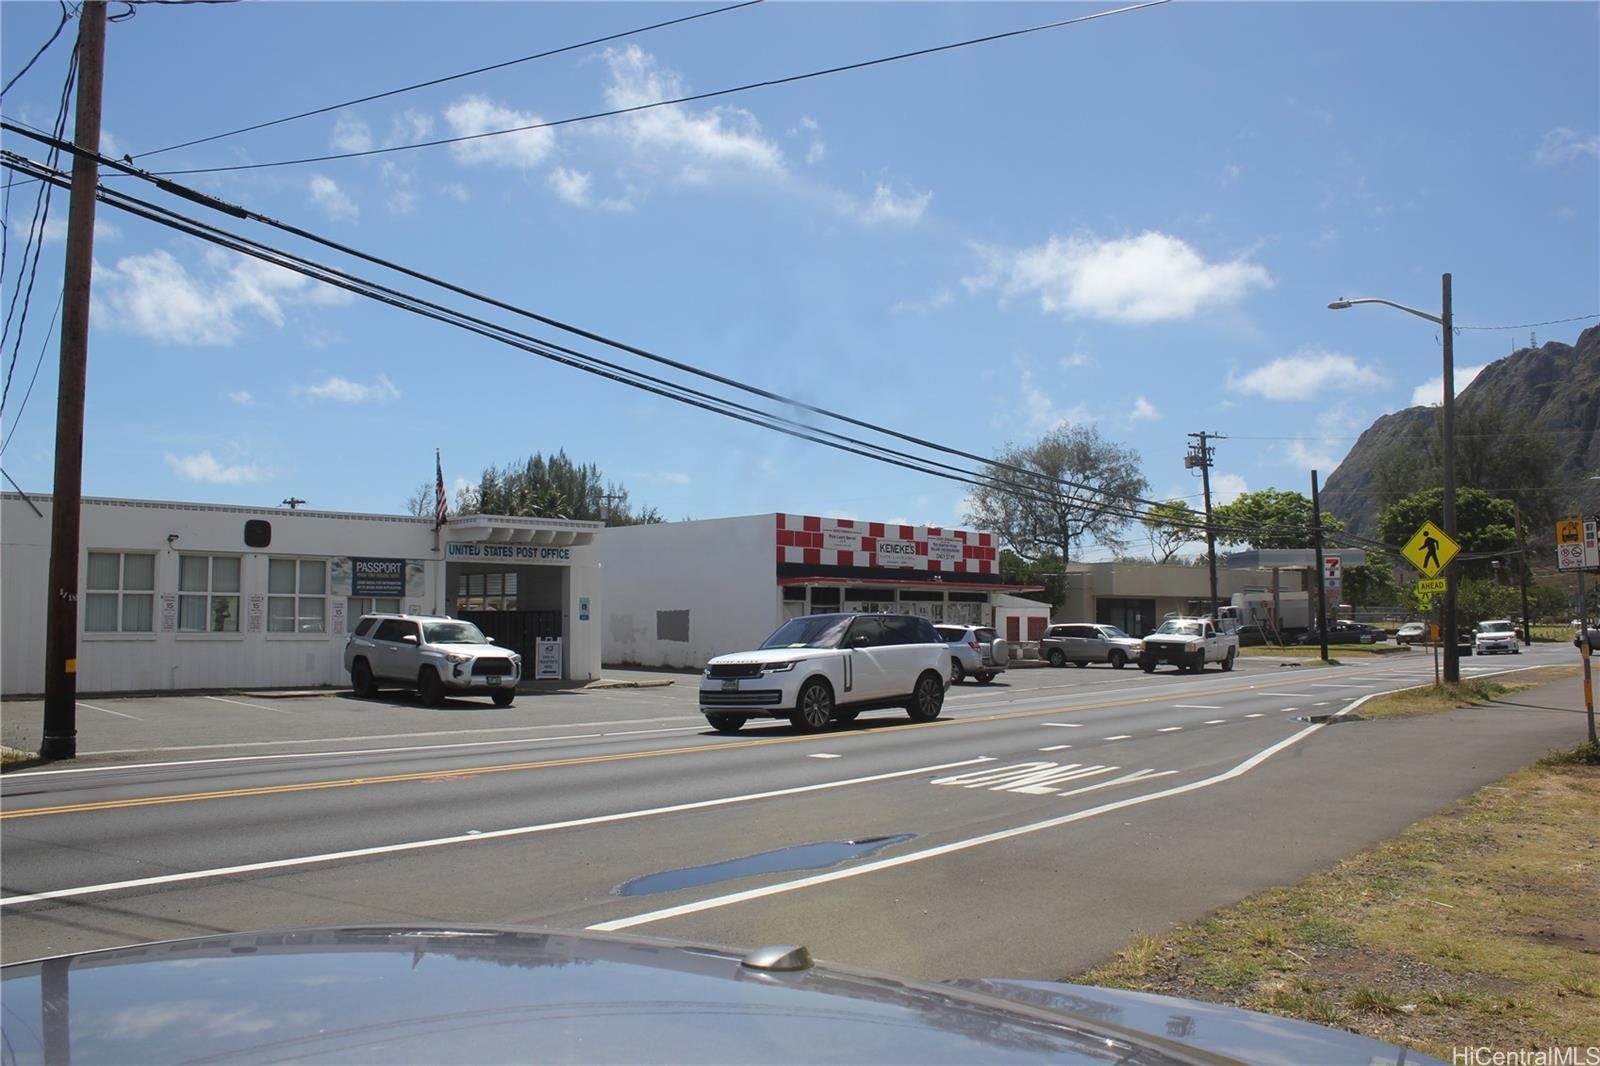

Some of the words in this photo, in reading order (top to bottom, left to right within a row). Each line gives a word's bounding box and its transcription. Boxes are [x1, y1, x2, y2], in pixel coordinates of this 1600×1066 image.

[448, 544, 480, 556] UNITED
[484, 545, 514, 558] STATES
[516, 547, 538, 559] POST
[541, 548, 570, 560] OFFICE
[880, 543, 915, 555] KENEKE'S
[356, 562, 402, 573] PASSPORT
[1421, 581, 1444, 590] AHEAD
